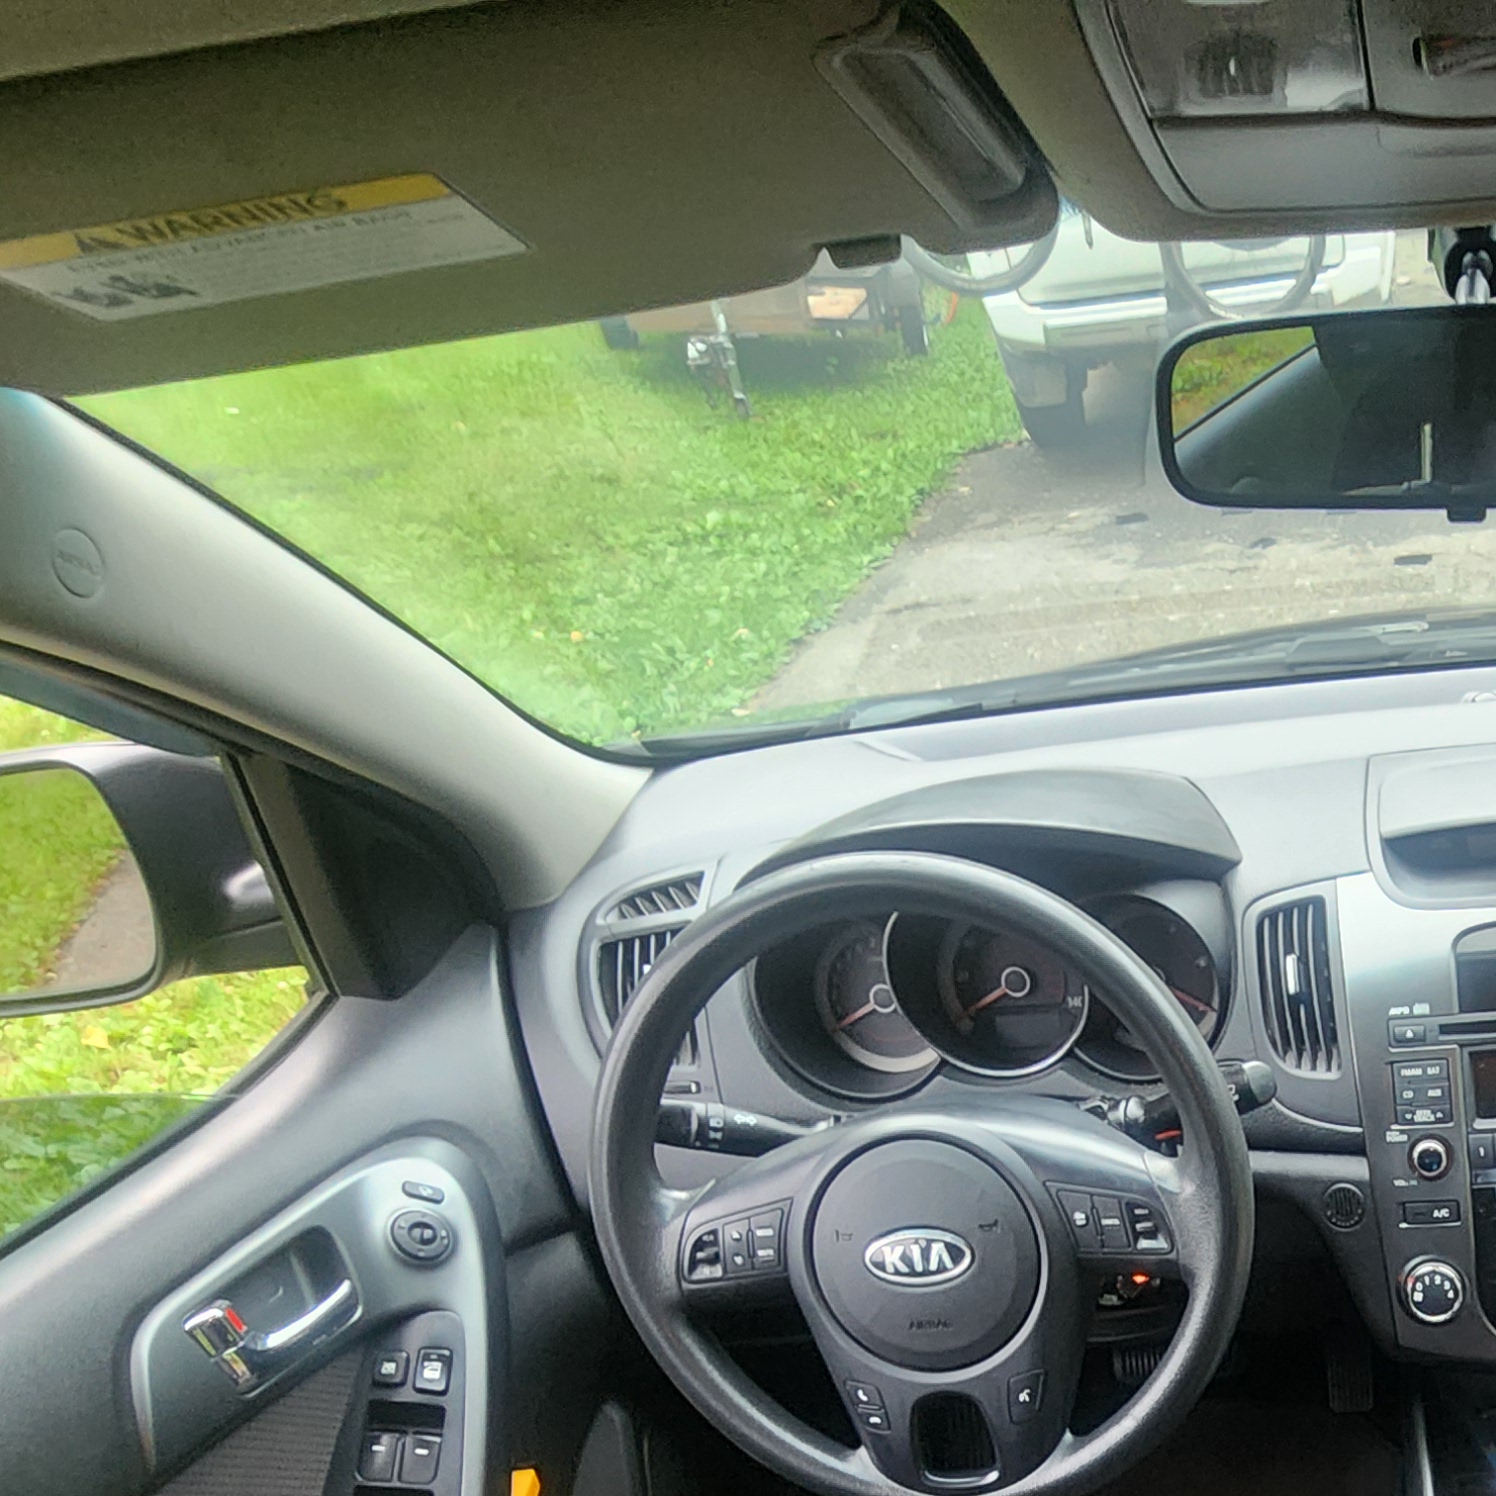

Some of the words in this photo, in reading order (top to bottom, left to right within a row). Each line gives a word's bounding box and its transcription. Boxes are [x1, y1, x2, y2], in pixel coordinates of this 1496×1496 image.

[114, 190, 347, 244] WARNING
[1432, 1208, 1450, 1218] A/C
[881, 1241, 955, 1274] KIA
